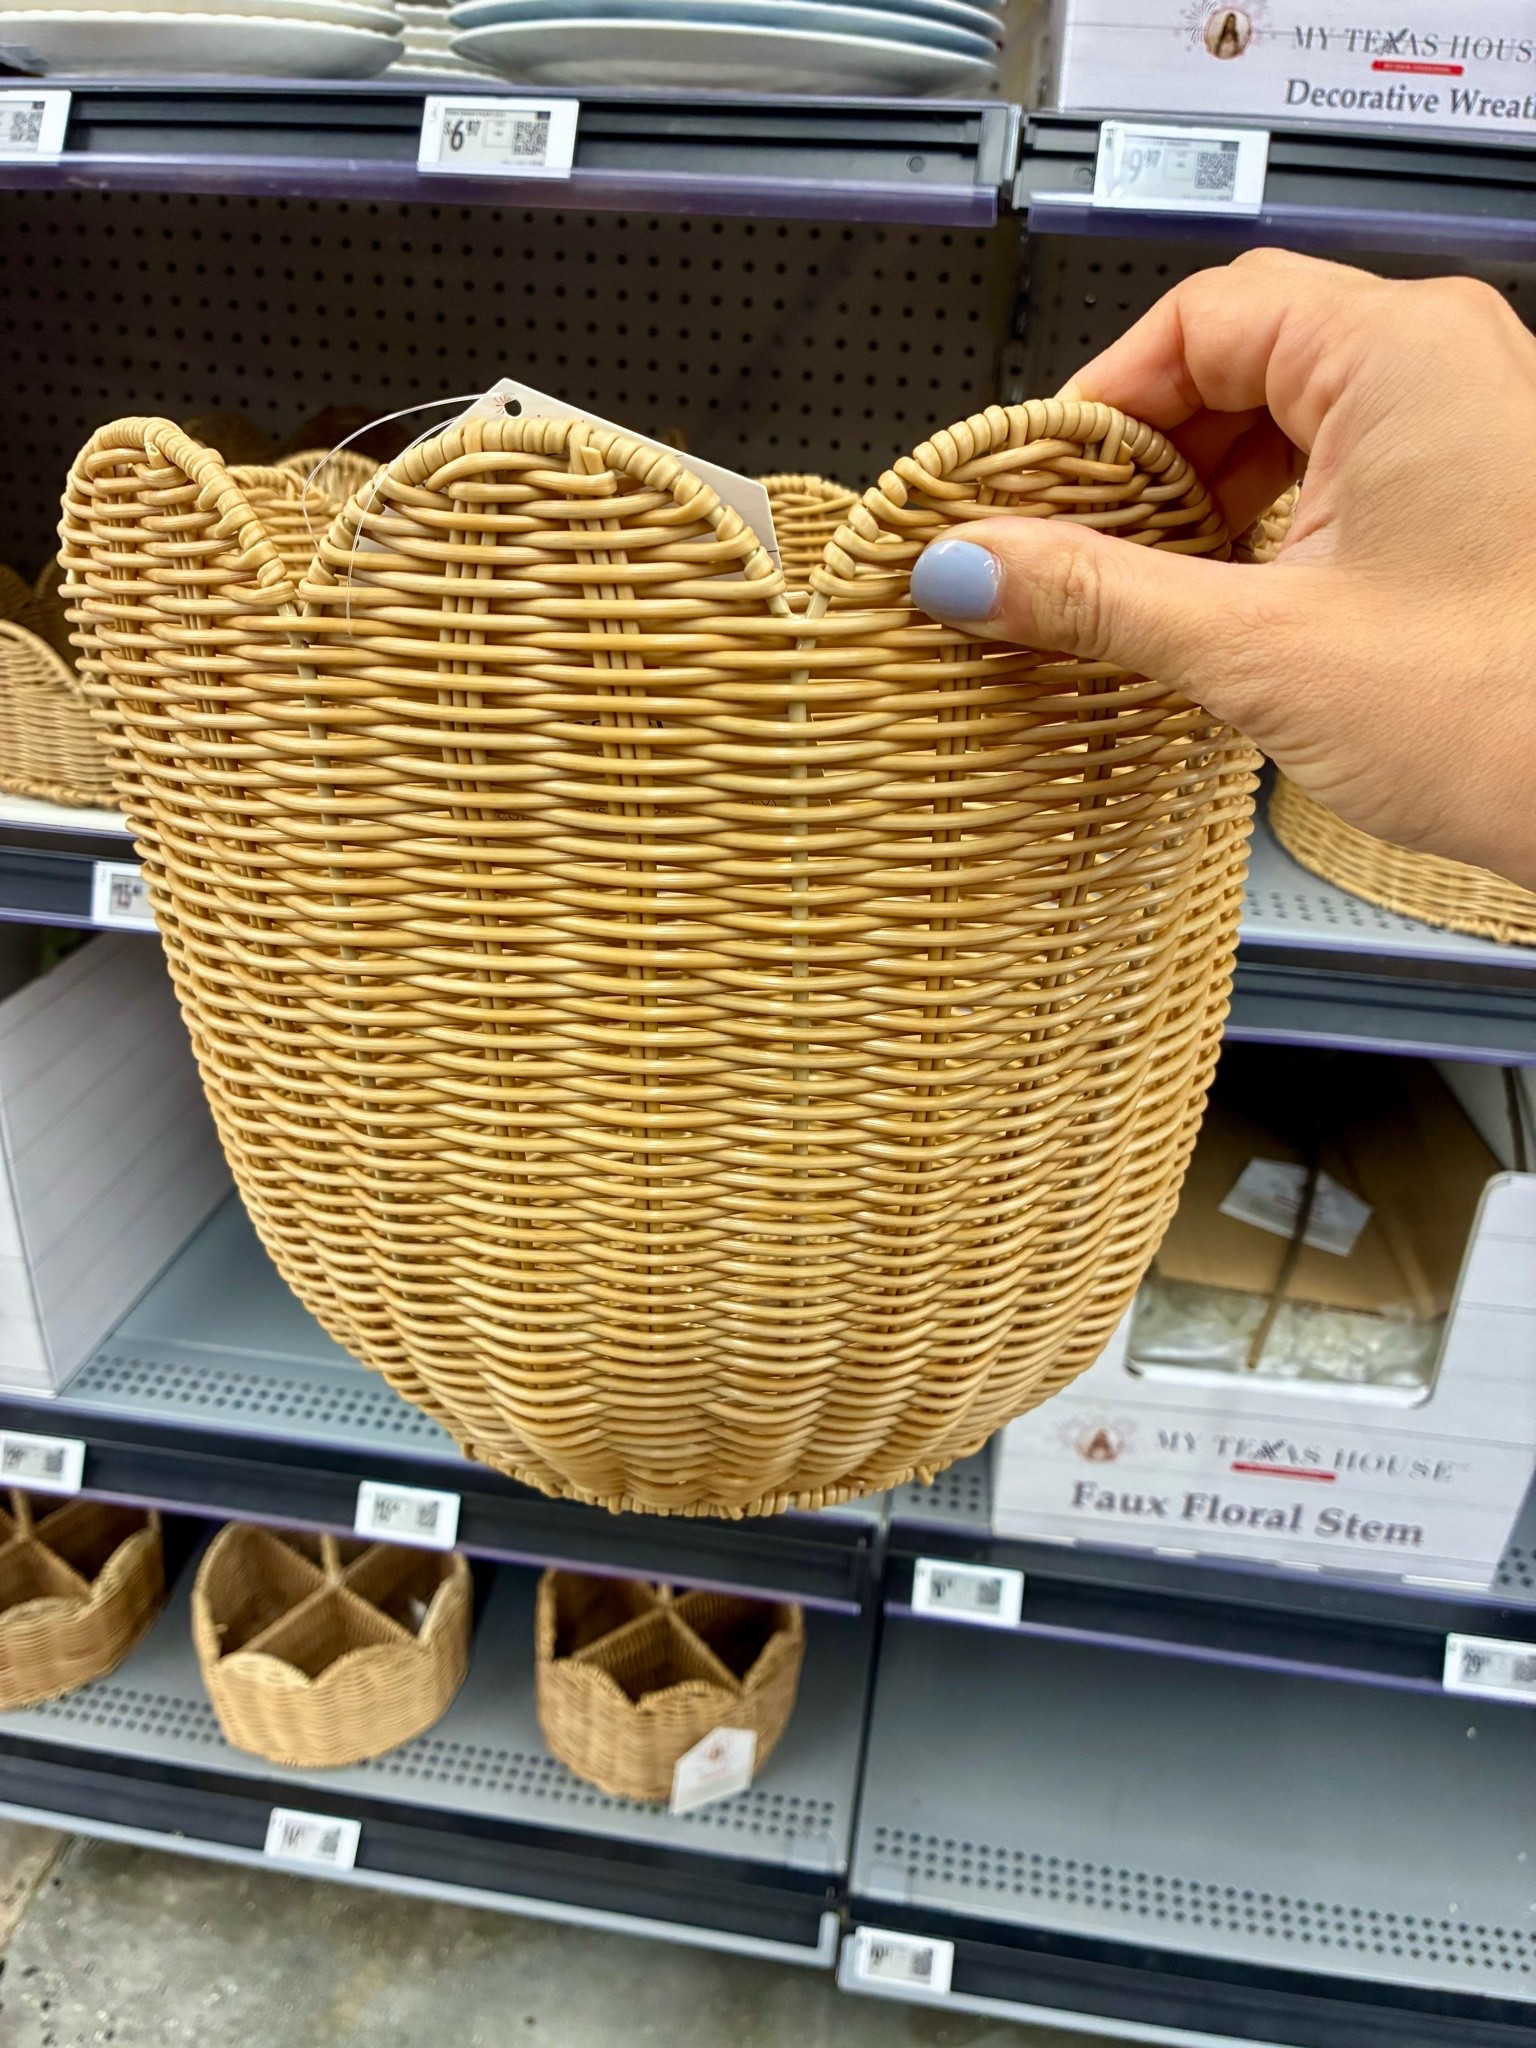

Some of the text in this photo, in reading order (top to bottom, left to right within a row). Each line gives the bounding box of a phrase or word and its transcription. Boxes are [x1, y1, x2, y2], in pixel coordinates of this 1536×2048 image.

[1291, 25, 1536, 63] MY TEXAS HOUS
[1285, 78, 1536, 120] Decorative Wreat
[1157, 1428, 1454, 1483] MY TEXAS HOUSE
[1071, 1480, 1424, 1548] Faux Floral Stem
